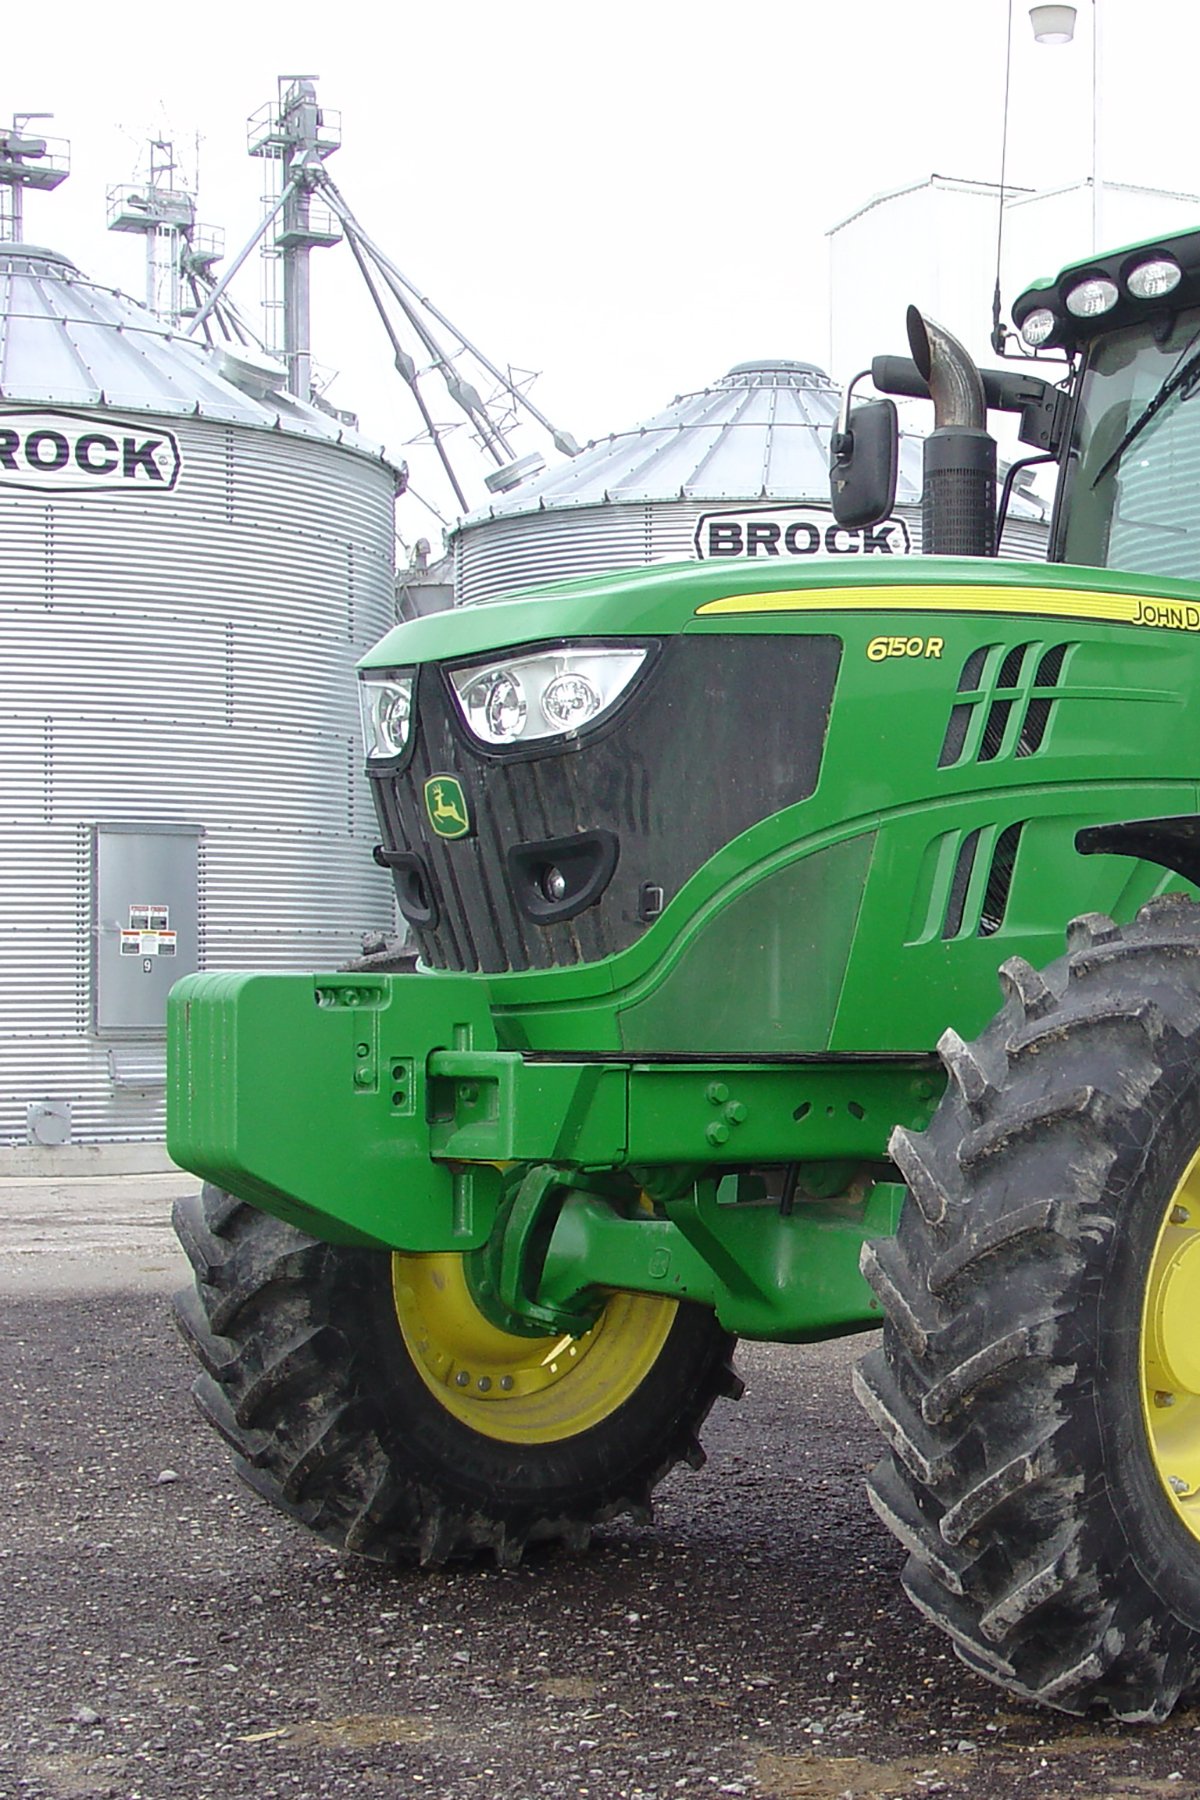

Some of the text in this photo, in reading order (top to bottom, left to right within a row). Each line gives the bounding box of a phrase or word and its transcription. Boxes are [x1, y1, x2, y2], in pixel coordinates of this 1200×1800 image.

[709, 522, 895, 556] BROCK
[1133, 601, 1183, 627] JOHN
[866, 635, 944, 662] 6150R
[144, 959, 152, 972] 9
